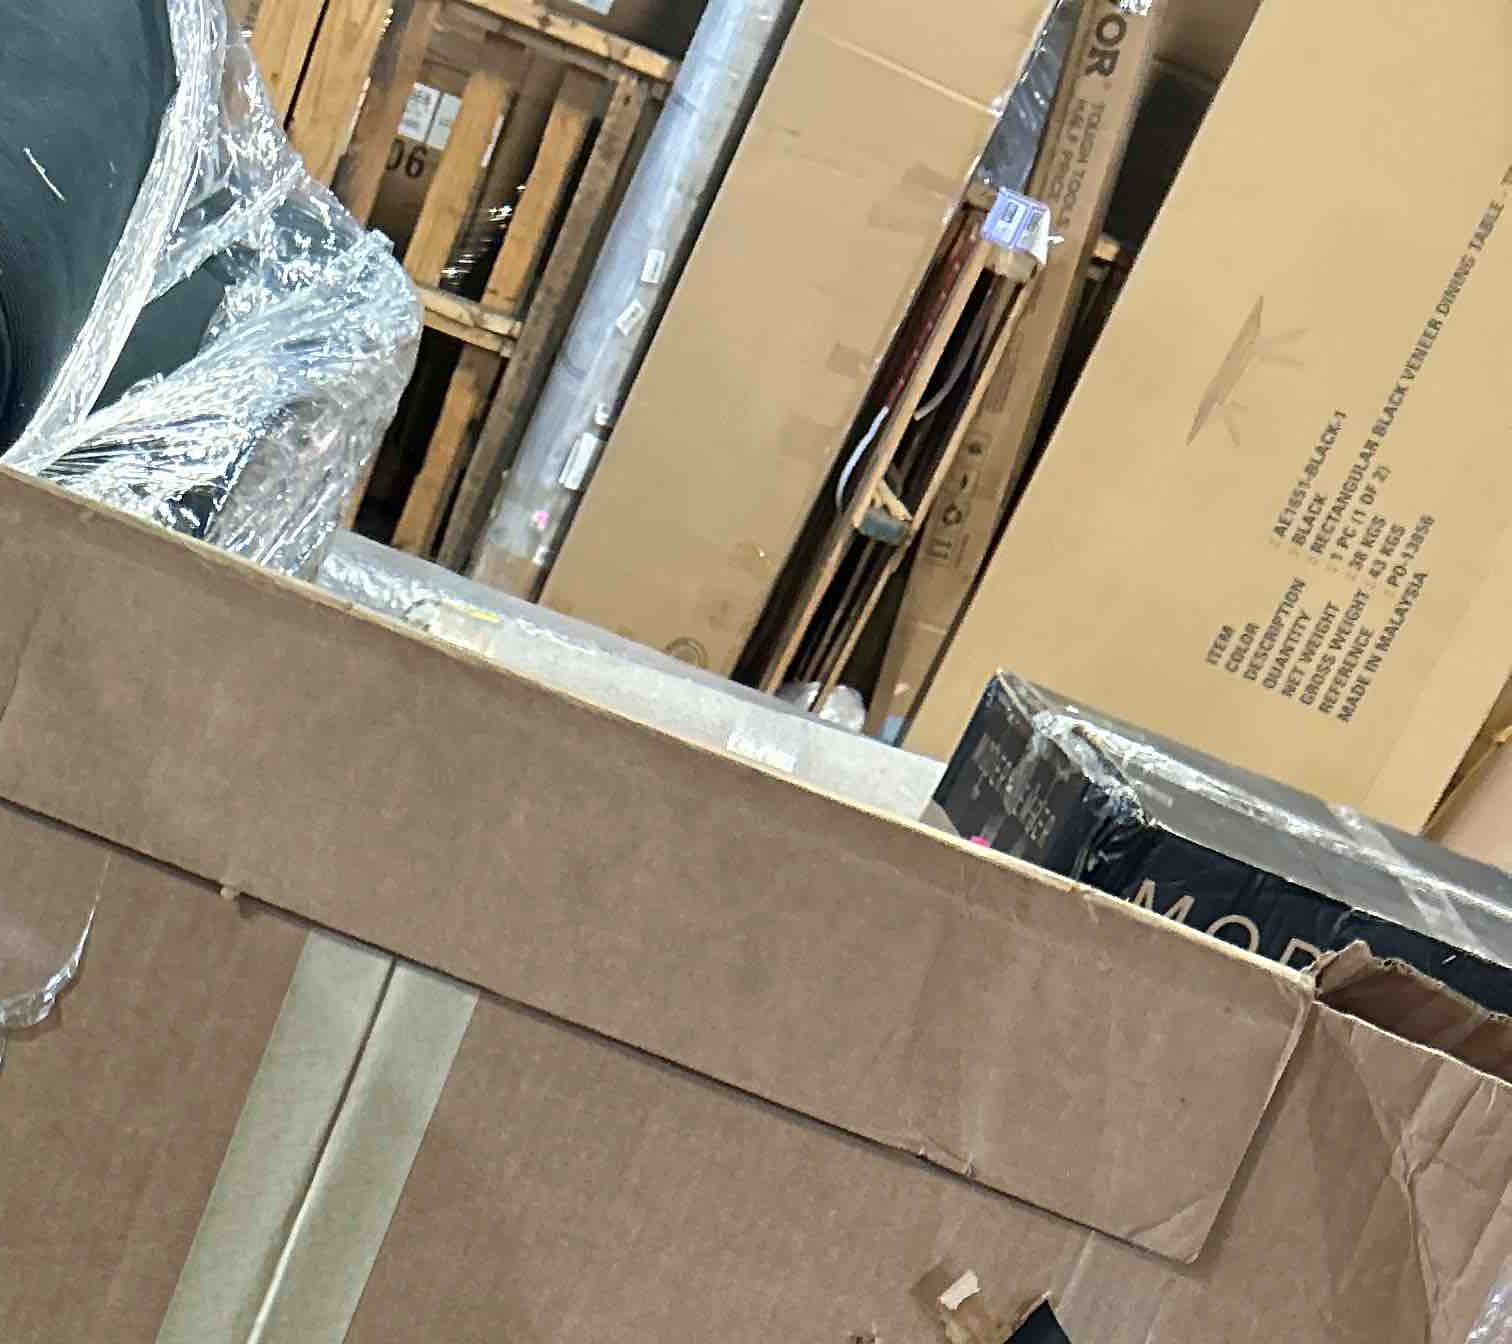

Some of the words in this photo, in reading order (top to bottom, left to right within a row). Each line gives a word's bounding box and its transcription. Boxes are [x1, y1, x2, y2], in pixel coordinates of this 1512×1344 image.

[1085, 12, 1127, 77] OR
[1242, 577, 1306, 682] DESCRIPTION
[1310, 438, 1379, 554] RECTANGULAR
[1371, 382, 1408, 436] BLACK
[1400, 317, 1442, 381] VENEER
[1434, 253, 1476, 317] DINING
[1467, 199, 1503, 252] TABLE
[1204, 623, 1235, 665] ITEM
[1223, 621, 1260, 673] COLOR
[1291, 491, 1328, 547] BLACK
[1262, 610, 1312, 690] QUANTITY
[1336, 525, 1357, 549] PC
[1360, 483, 1379, 505] OF
[1281, 665, 1306, 698] NET
[1298, 600, 1341, 665] WEIGHT
[1360, 514, 1386, 548] KGS
[1299, 652, 1336, 706] GROSS
[1327, 589, 1369, 652] WEIGHT
[1379, 523, 1405, 557] KGS
[1318, 625, 1373, 714] REFERENCE
[1337, 674, 1371, 722] MADE
[1363, 653, 1381, 672] IN
[1375, 568, 1427, 653] MALAYSIA
